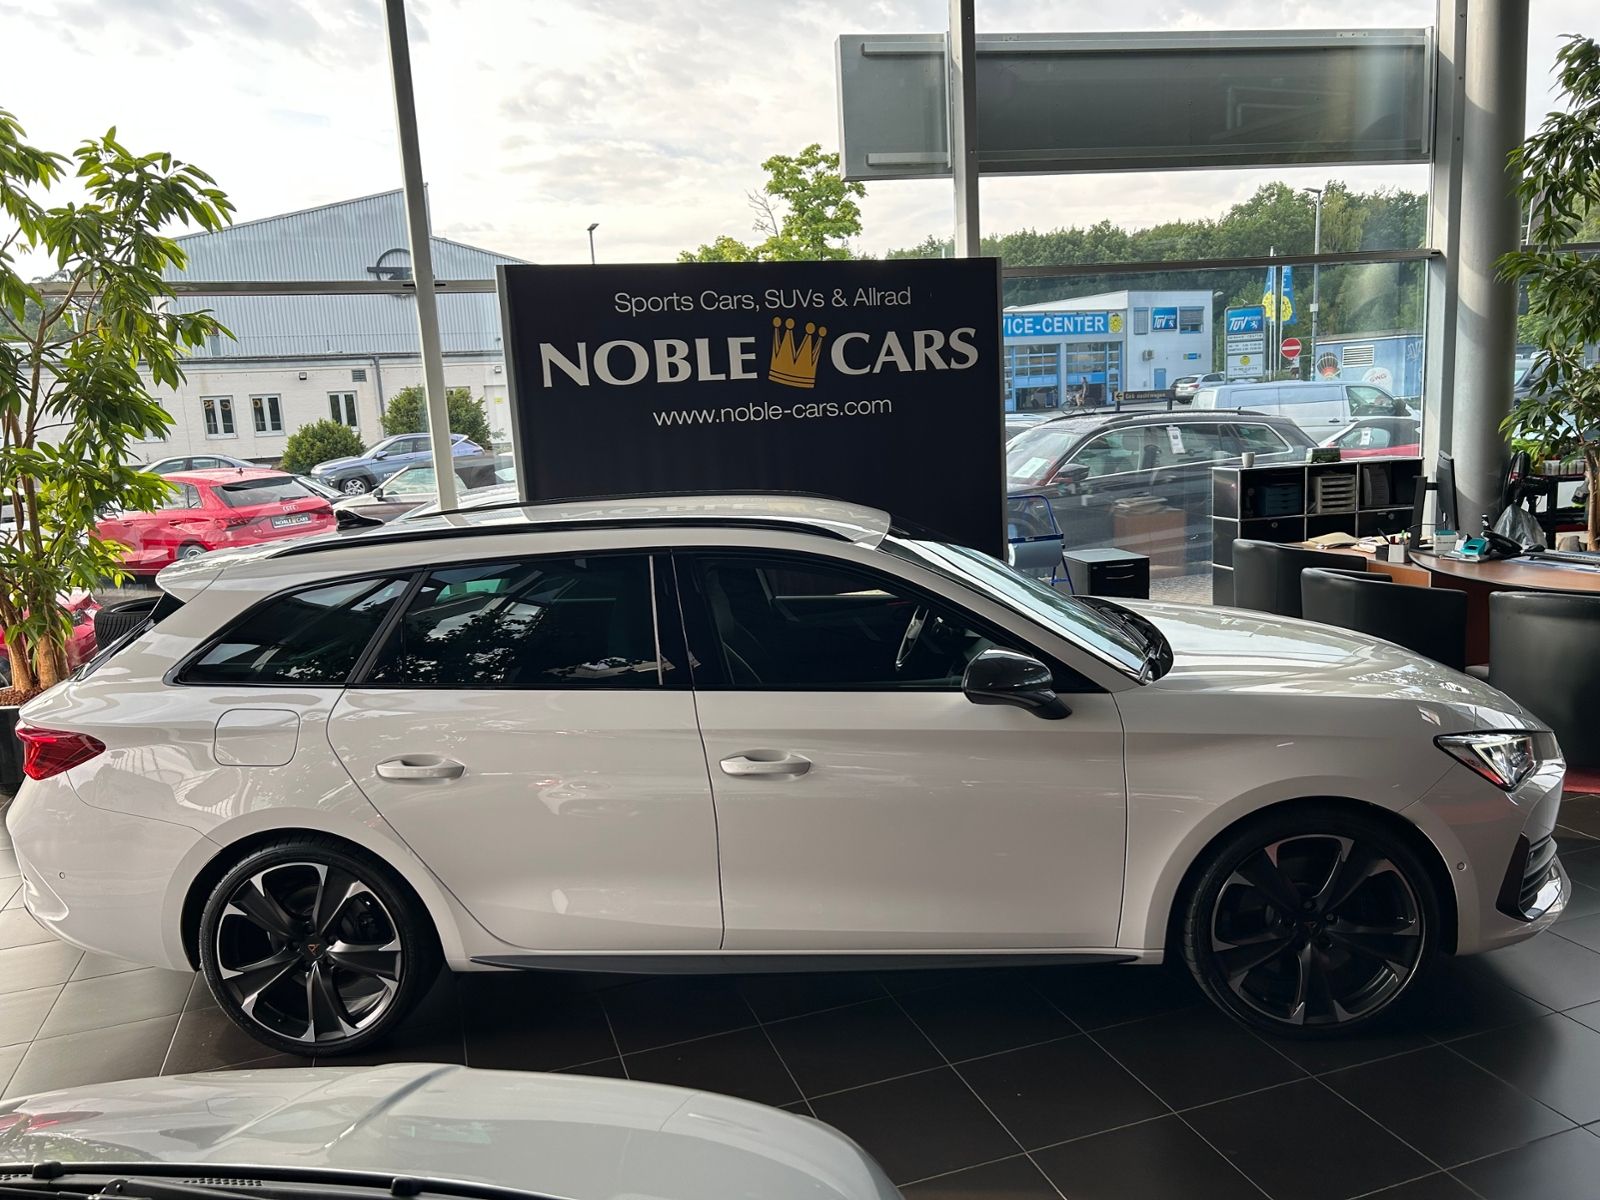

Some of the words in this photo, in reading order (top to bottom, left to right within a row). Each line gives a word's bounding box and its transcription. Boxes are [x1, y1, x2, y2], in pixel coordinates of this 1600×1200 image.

[614, 292, 694, 318] Sports
[700, 290, 760, 312] Cars,
[764, 289, 825, 309] SUVs
[831, 288, 849, 307] &
[853, 286, 911, 307] Allrad
[539, 336, 758, 388] NOBLE
[830, 327, 979, 375] CARS
[652, 399, 892, 427] www.noble-cars.com
